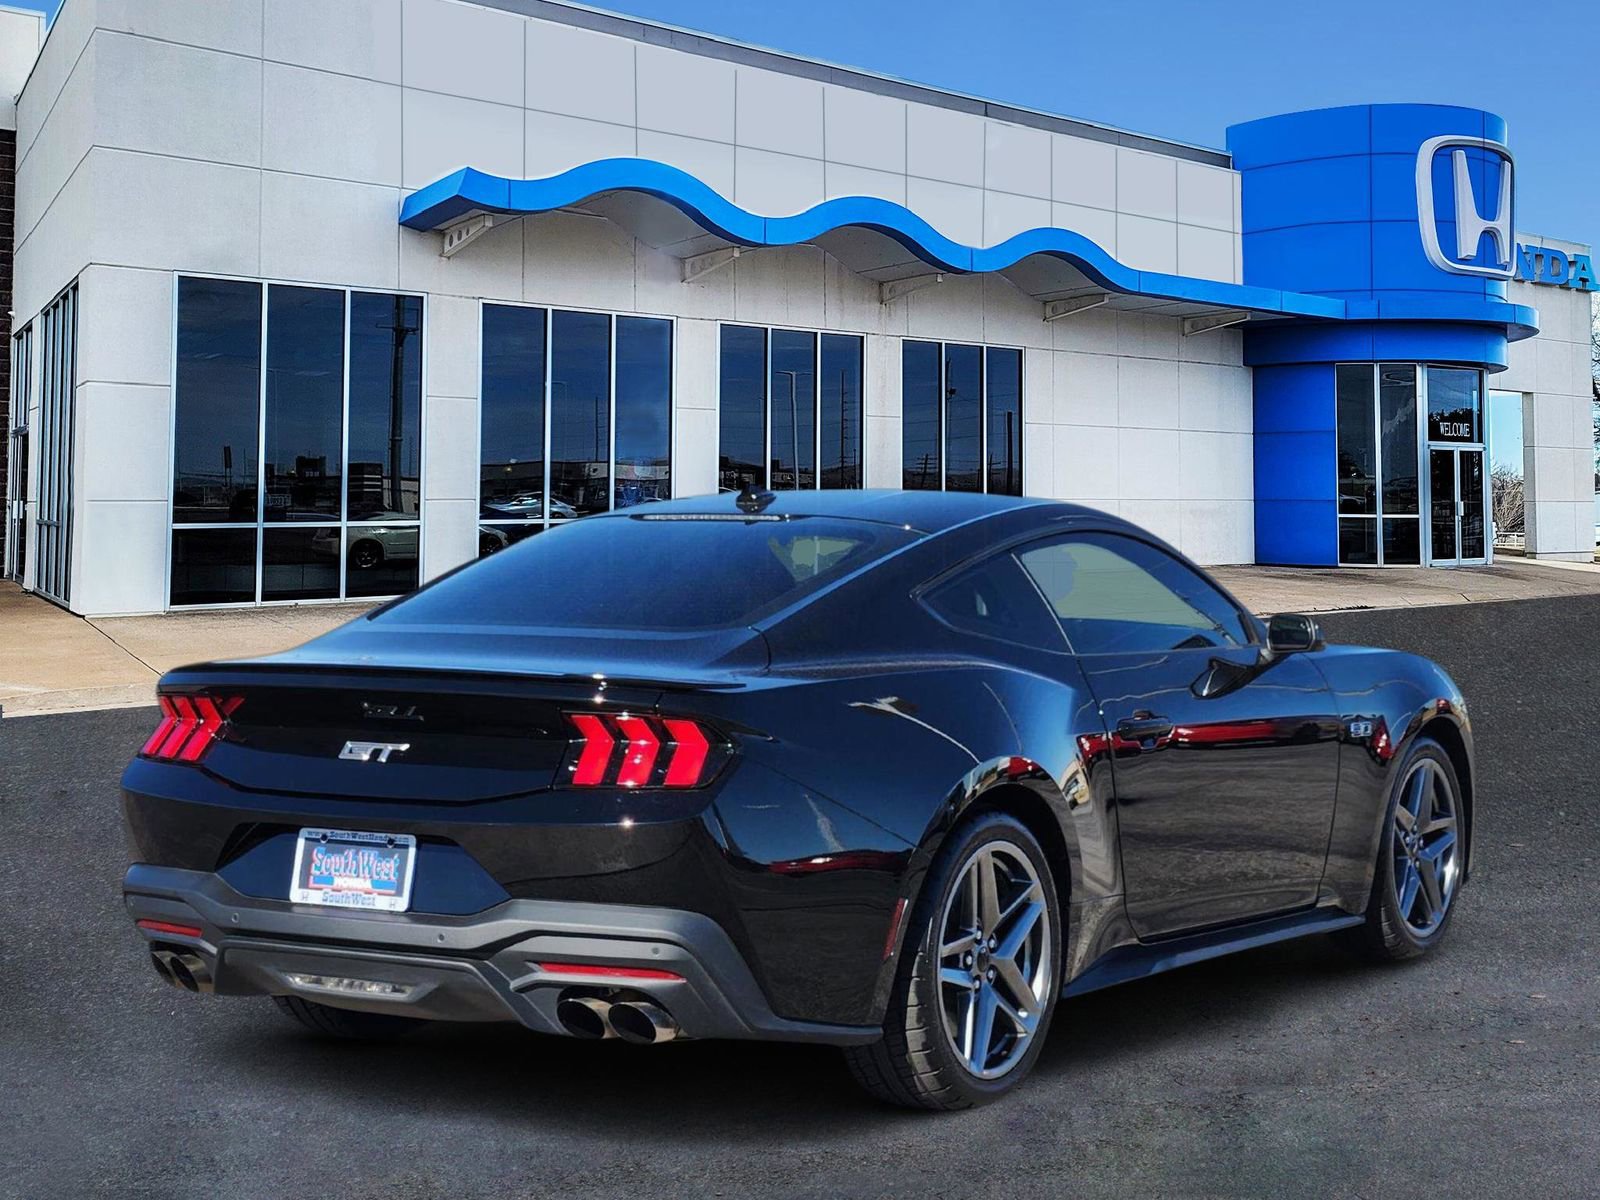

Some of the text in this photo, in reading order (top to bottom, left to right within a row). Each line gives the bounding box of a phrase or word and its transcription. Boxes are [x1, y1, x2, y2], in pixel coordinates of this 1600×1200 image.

[1516, 243, 1600, 291] NDA
[1440, 422, 1470, 437] WELCOME
[338, 740, 410, 763] GT
[310, 845, 400, 881] SouthWest
[322, 890, 377, 907] SouthWest
